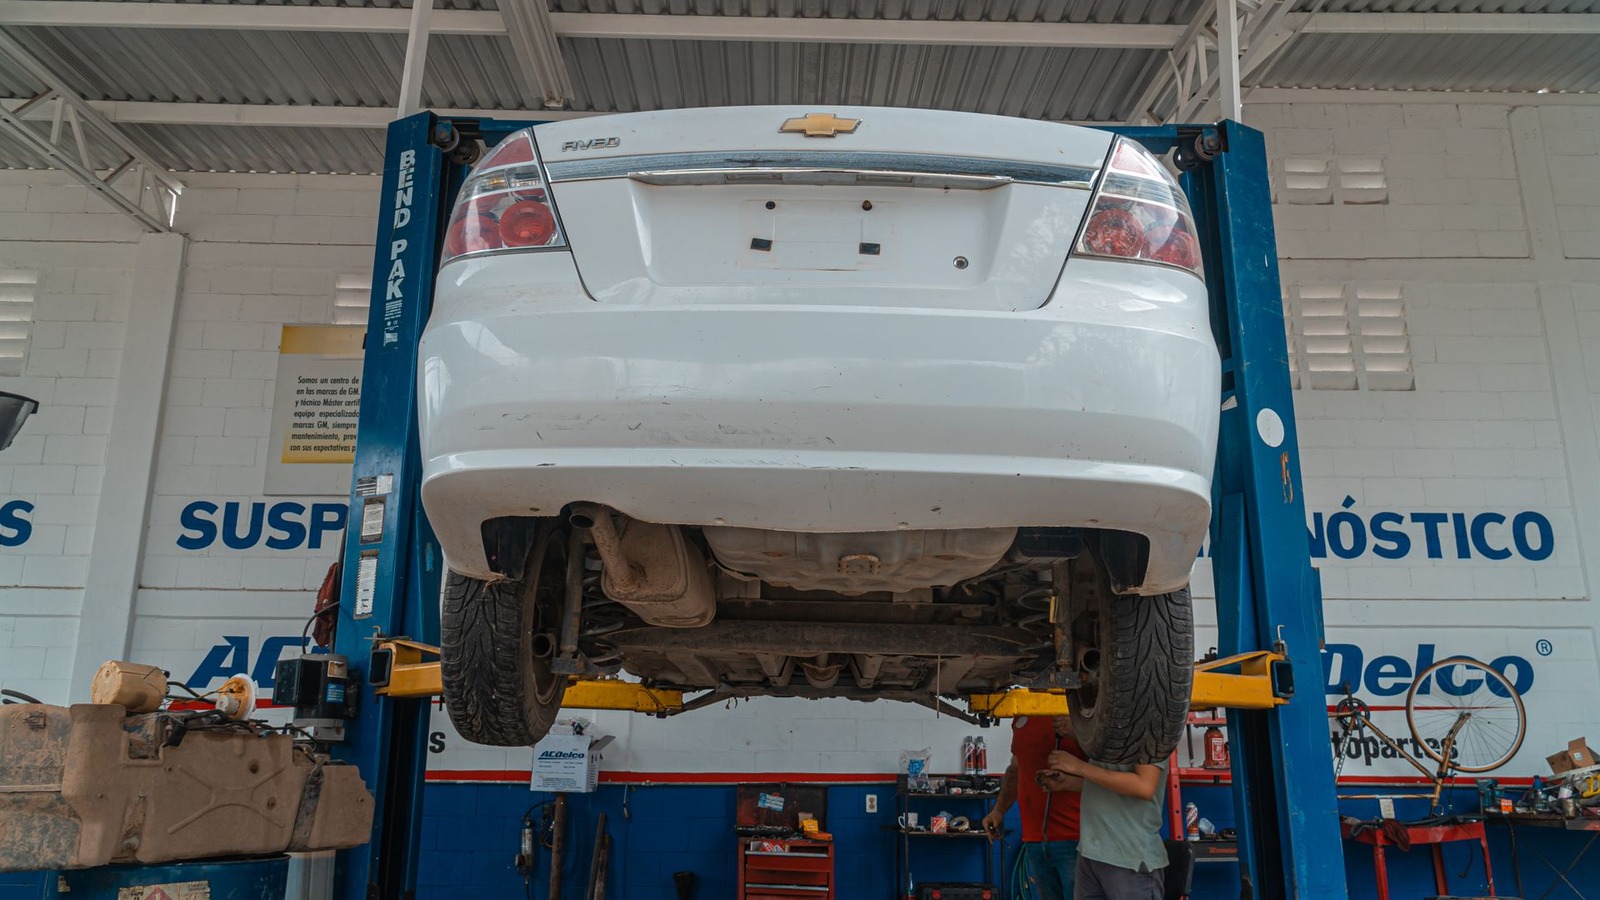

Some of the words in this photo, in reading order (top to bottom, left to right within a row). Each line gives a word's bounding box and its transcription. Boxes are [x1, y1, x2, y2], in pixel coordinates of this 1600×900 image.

[561, 137, 620, 152] AVEO
[394, 149, 415, 229] BEND
[386, 238, 408, 300] PAK
[297, 376, 318, 384] Somos
[351, 376, 359, 384] de
[305, 387, 315, 395] las
[339, 387, 347, 395] de
[300, 398, 321, 406] técnico
[322, 398, 343, 406] Máster
[293, 410, 315, 418] equipo
[332, 421, 357, 430] siempre
[291, 432, 340, 441] mantenimiento,
[313, 444, 350, 453] expectativas
[186, 635, 331, 688] AC
[540, 750, 585, 760] ACDelco
